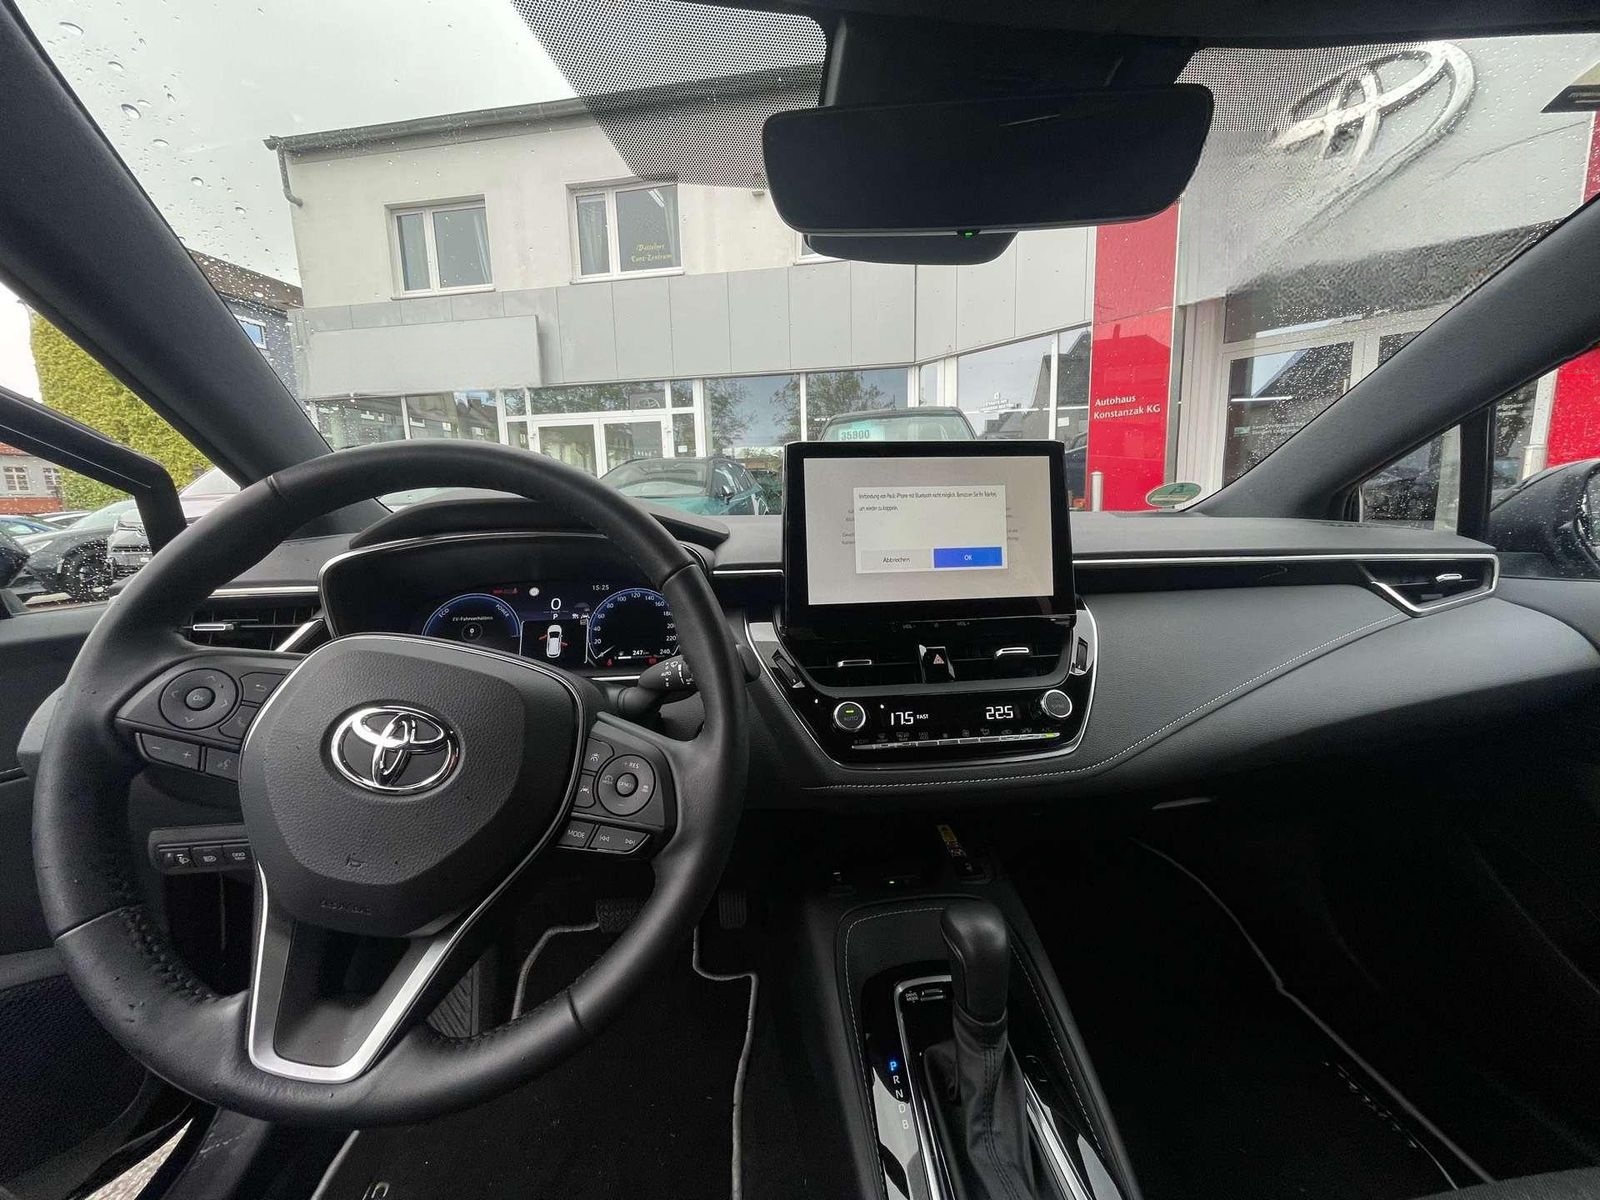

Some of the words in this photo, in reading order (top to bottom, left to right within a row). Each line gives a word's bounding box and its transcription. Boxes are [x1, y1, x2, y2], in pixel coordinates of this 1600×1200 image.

[1094, 395, 1136, 407] Autohaus
[1093, 406, 1144, 420] Konstanzak
[1146, 403, 1161, 414] KG
[550, 598, 562, 610] 0
[438, 607, 450, 618] ECO
[568, 829, 585, 839] MODE
[889, 1061, 897, 1071] P
[893, 1075, 900, 1085] R
[895, 1089, 904, 1099] N
[902, 1119, 909, 1130] B
